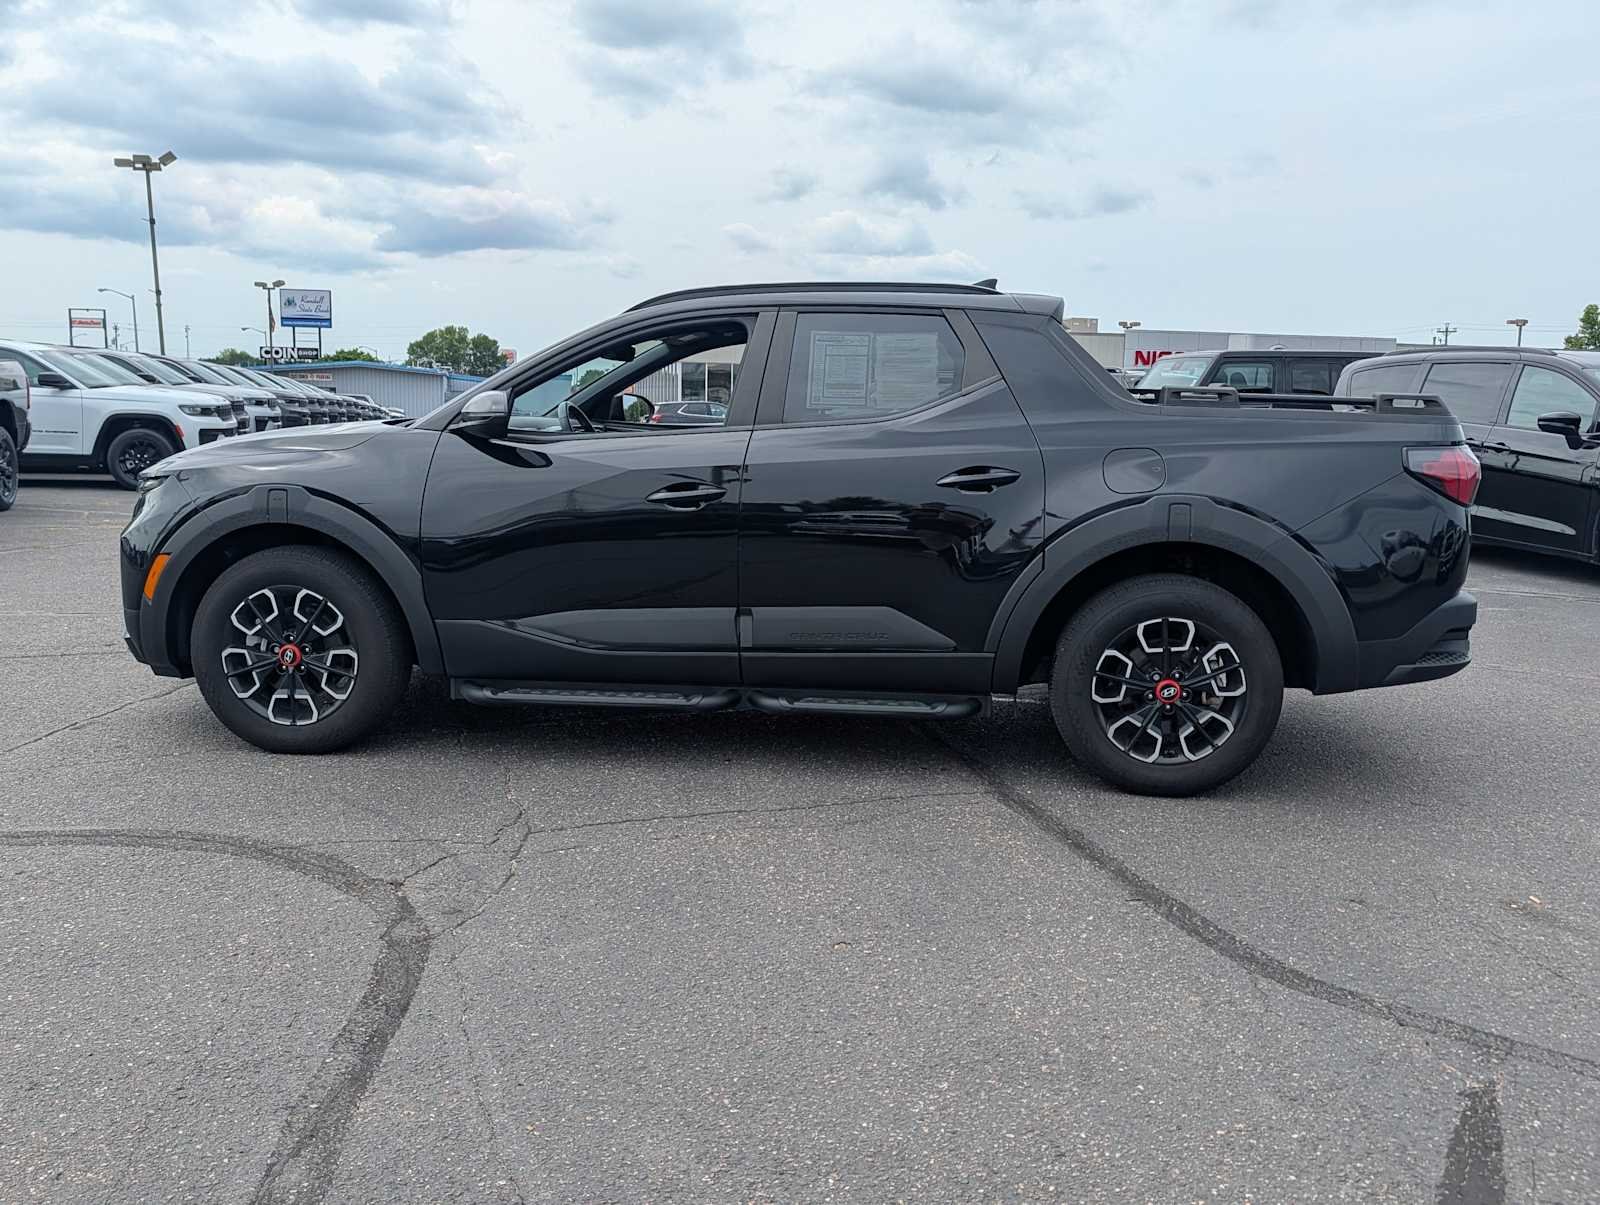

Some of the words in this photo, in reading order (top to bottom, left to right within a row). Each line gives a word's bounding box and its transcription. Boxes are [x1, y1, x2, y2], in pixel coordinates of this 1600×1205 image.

[297, 303, 313, 313] State
[314, 304, 329, 313] Bank
[260, 347, 298, 359] COIN
